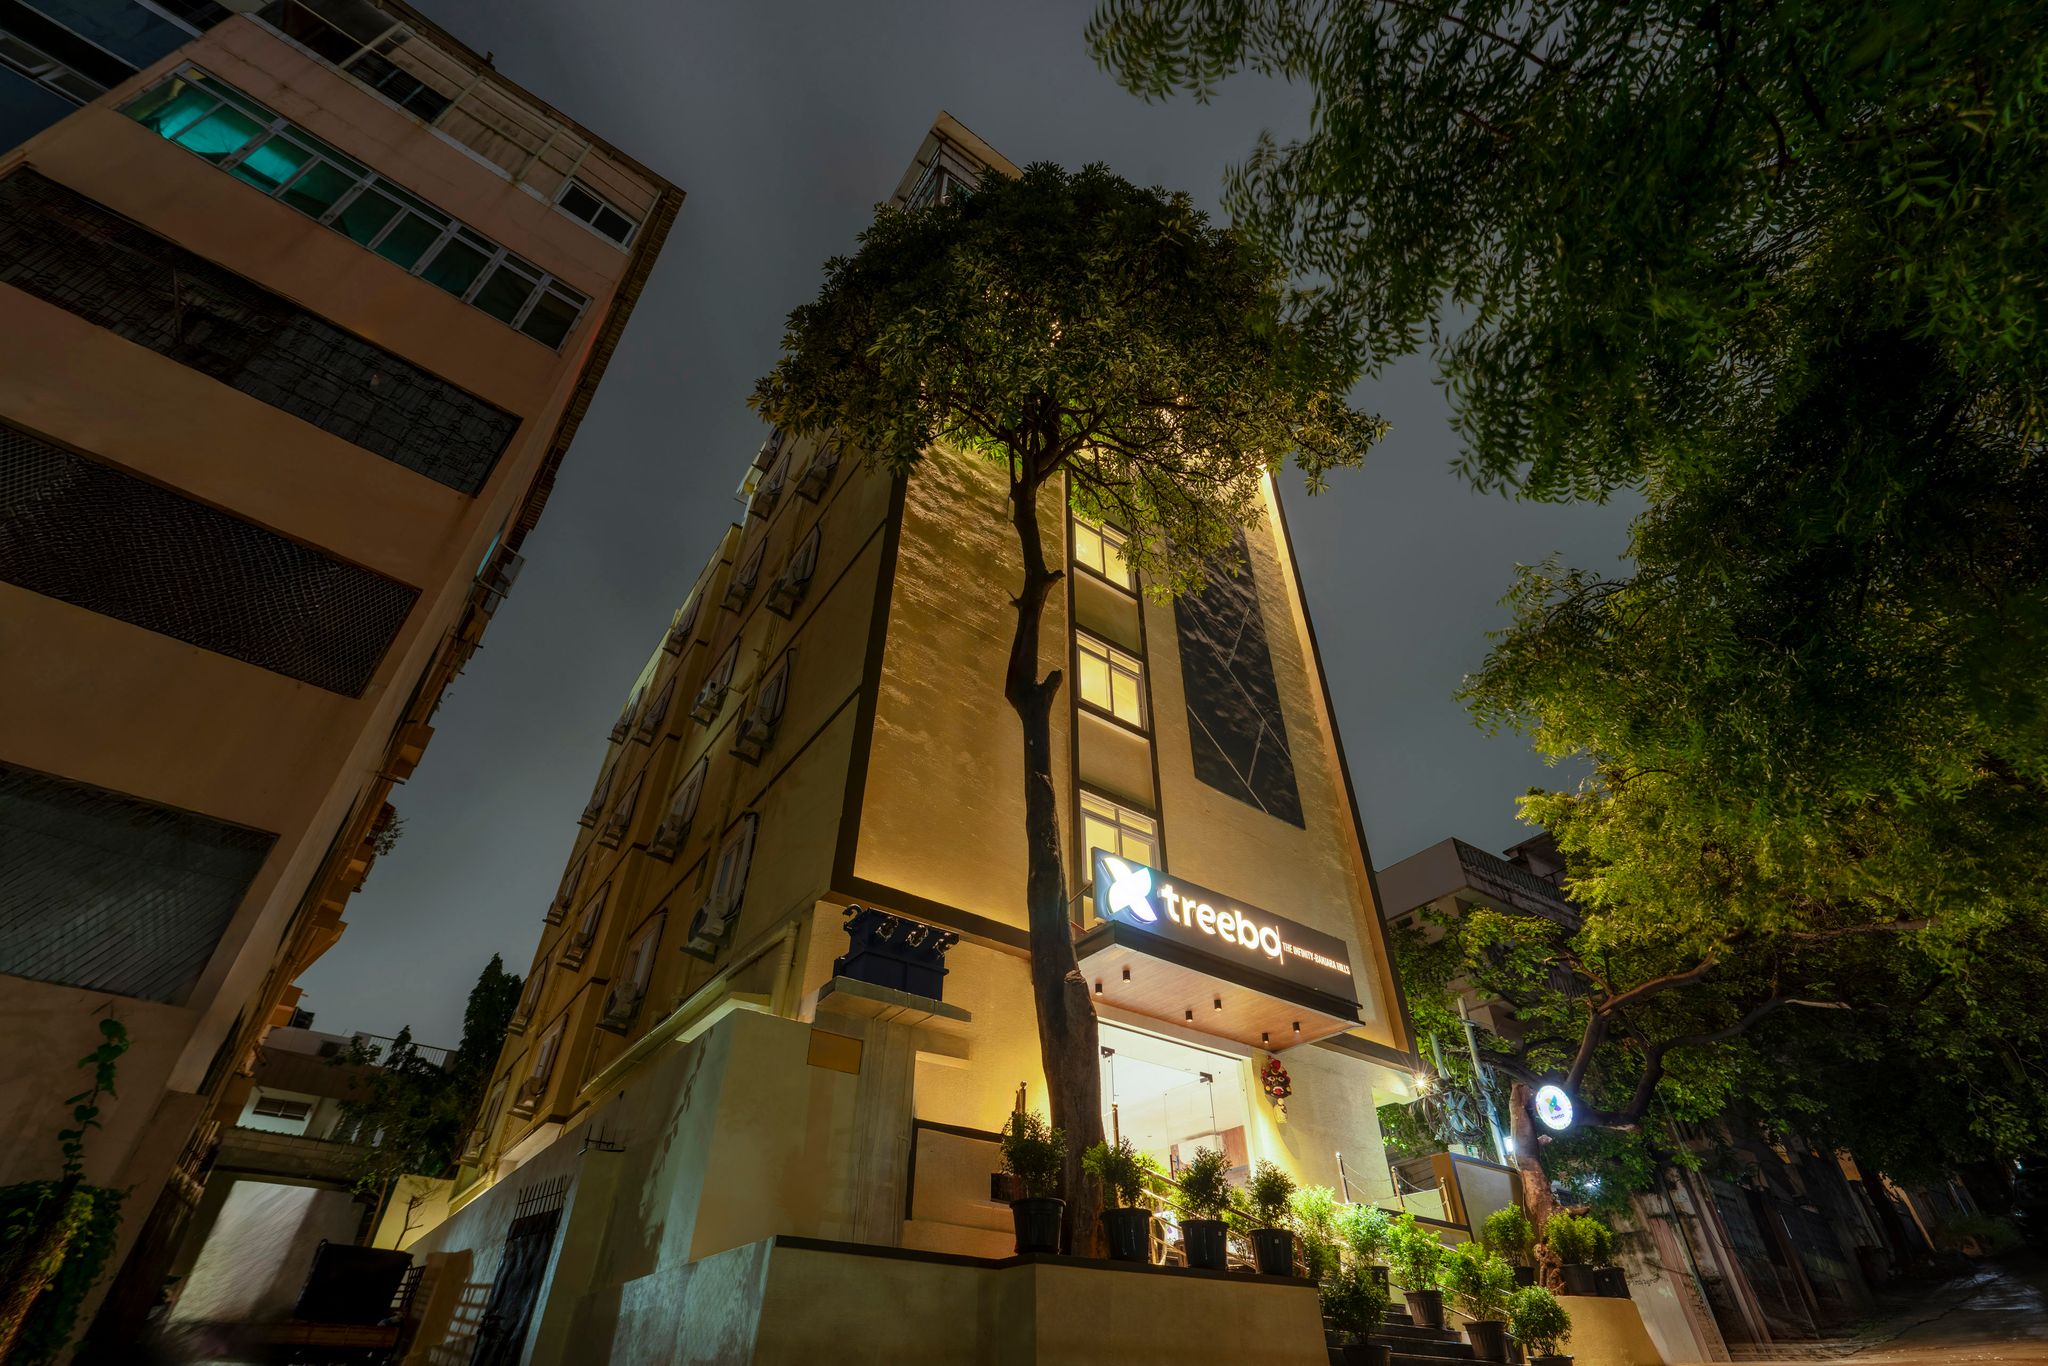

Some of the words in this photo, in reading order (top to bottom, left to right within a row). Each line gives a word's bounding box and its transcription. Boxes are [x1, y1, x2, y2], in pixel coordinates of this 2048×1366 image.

[1159, 884, 1281, 957] treebo
[1282, 942, 1293, 953] THE
[1336, 962, 1351, 975] HILLS
